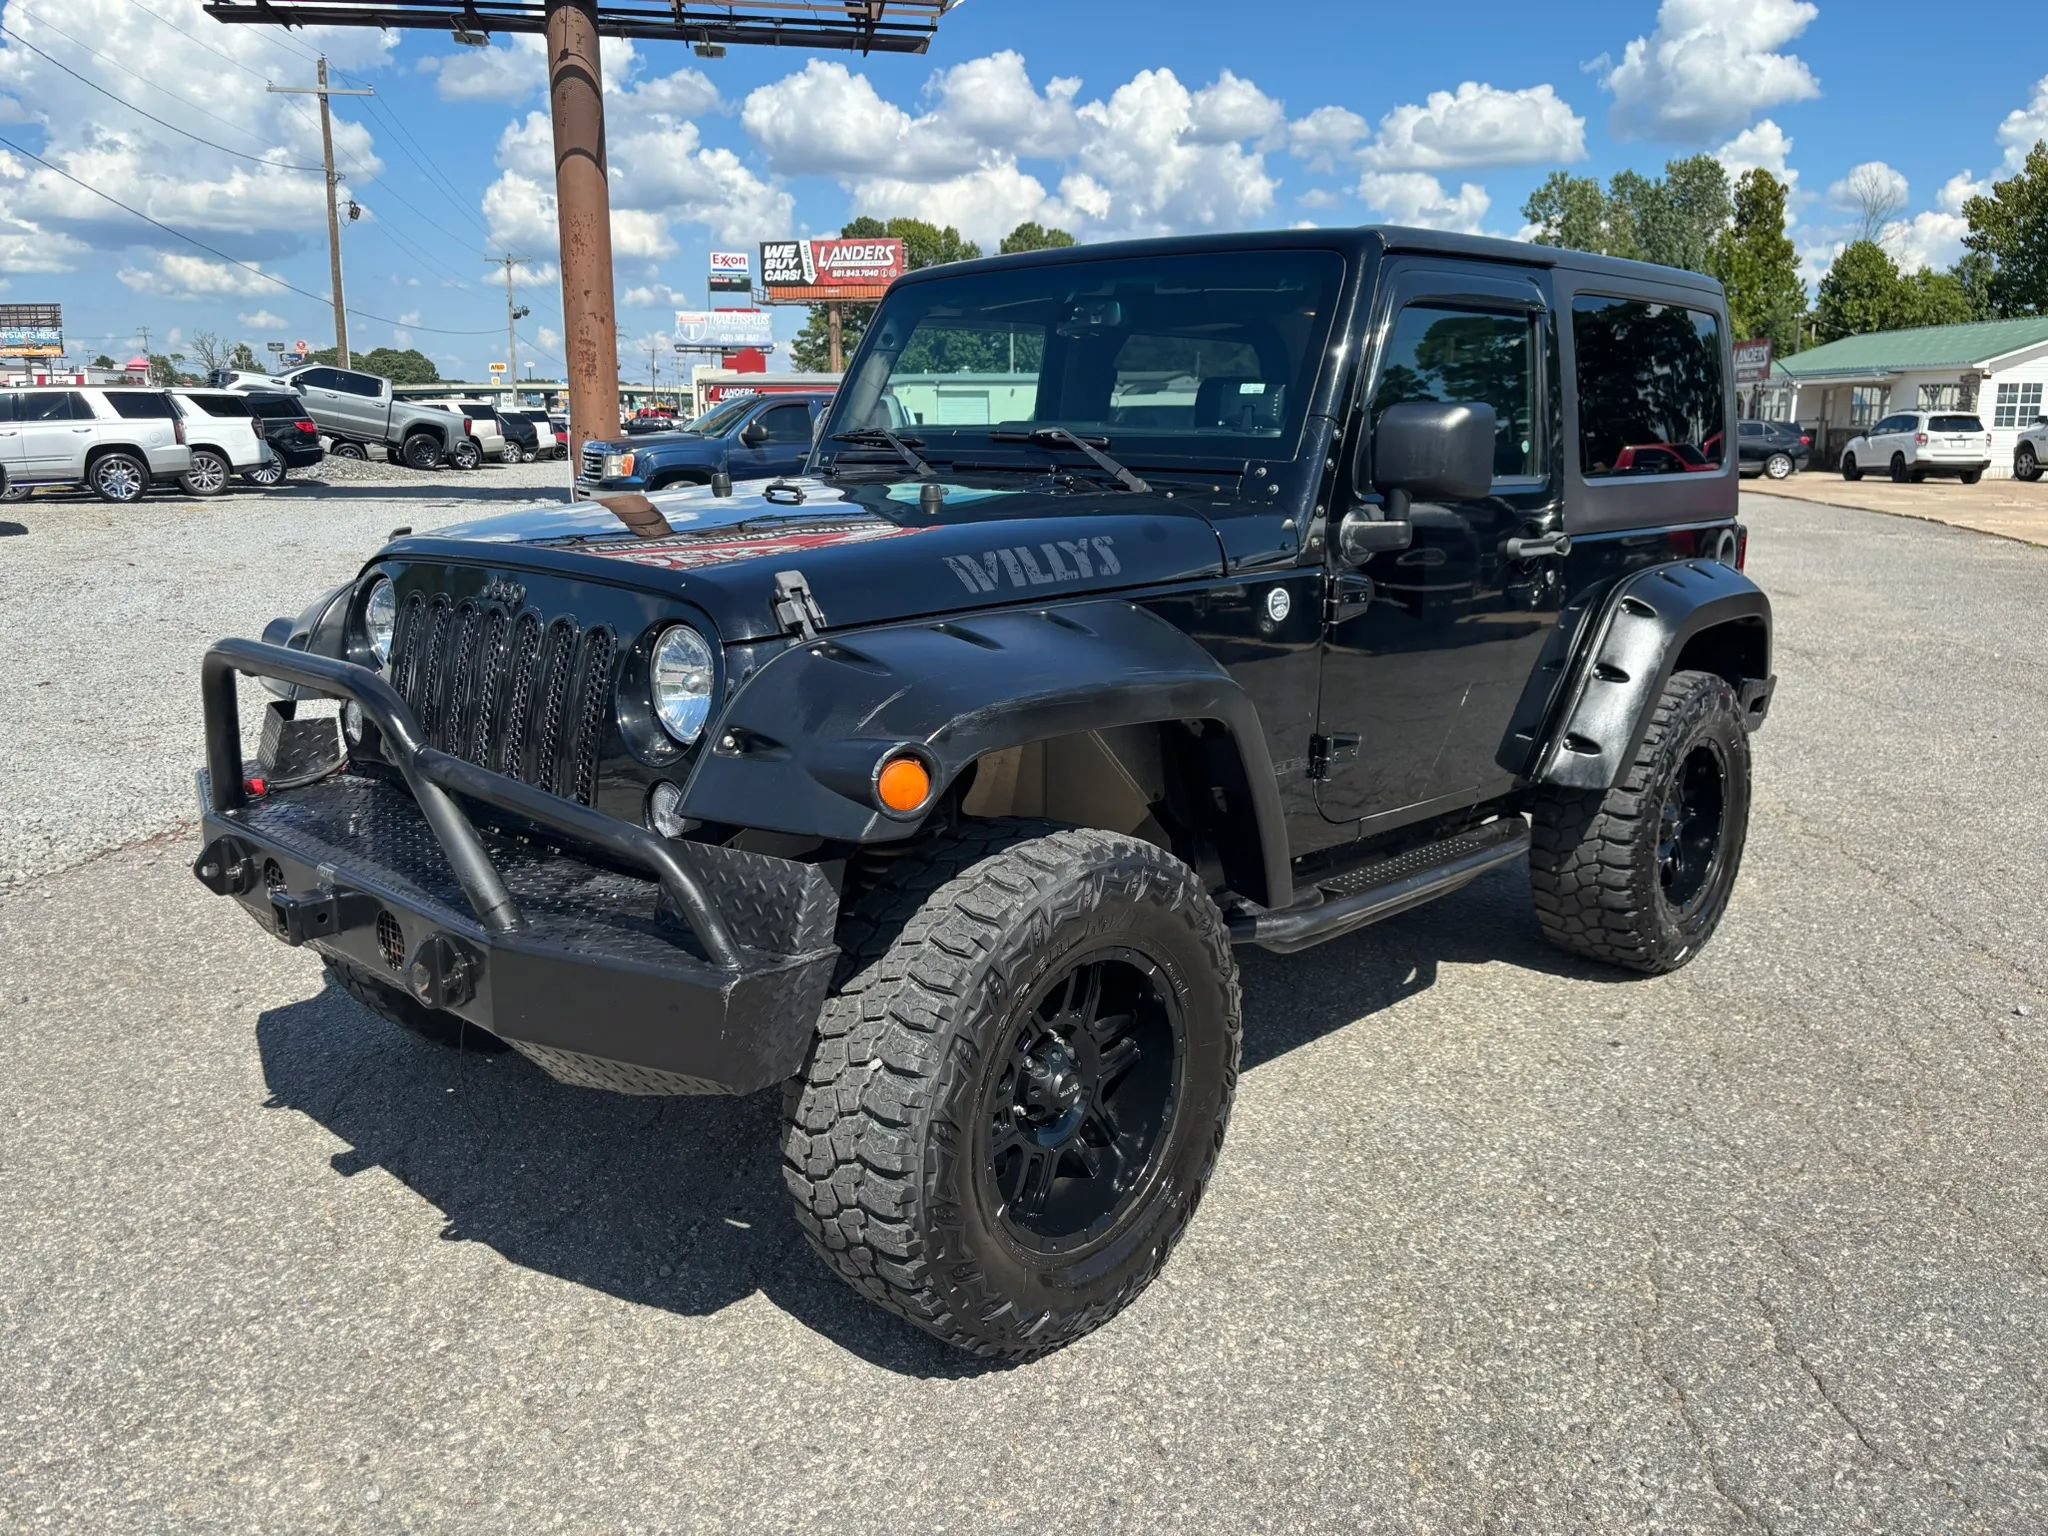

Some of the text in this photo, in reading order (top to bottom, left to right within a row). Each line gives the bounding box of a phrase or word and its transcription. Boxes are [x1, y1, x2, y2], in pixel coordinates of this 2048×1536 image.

[764, 245, 797, 258] WE
[818, 245, 895, 271] LANDERS
[712, 254, 746, 268] Exxon
[764, 258, 799, 270] BUY
[764, 269, 801, 281] CARS!
[942, 536, 1121, 594] WILLYS
